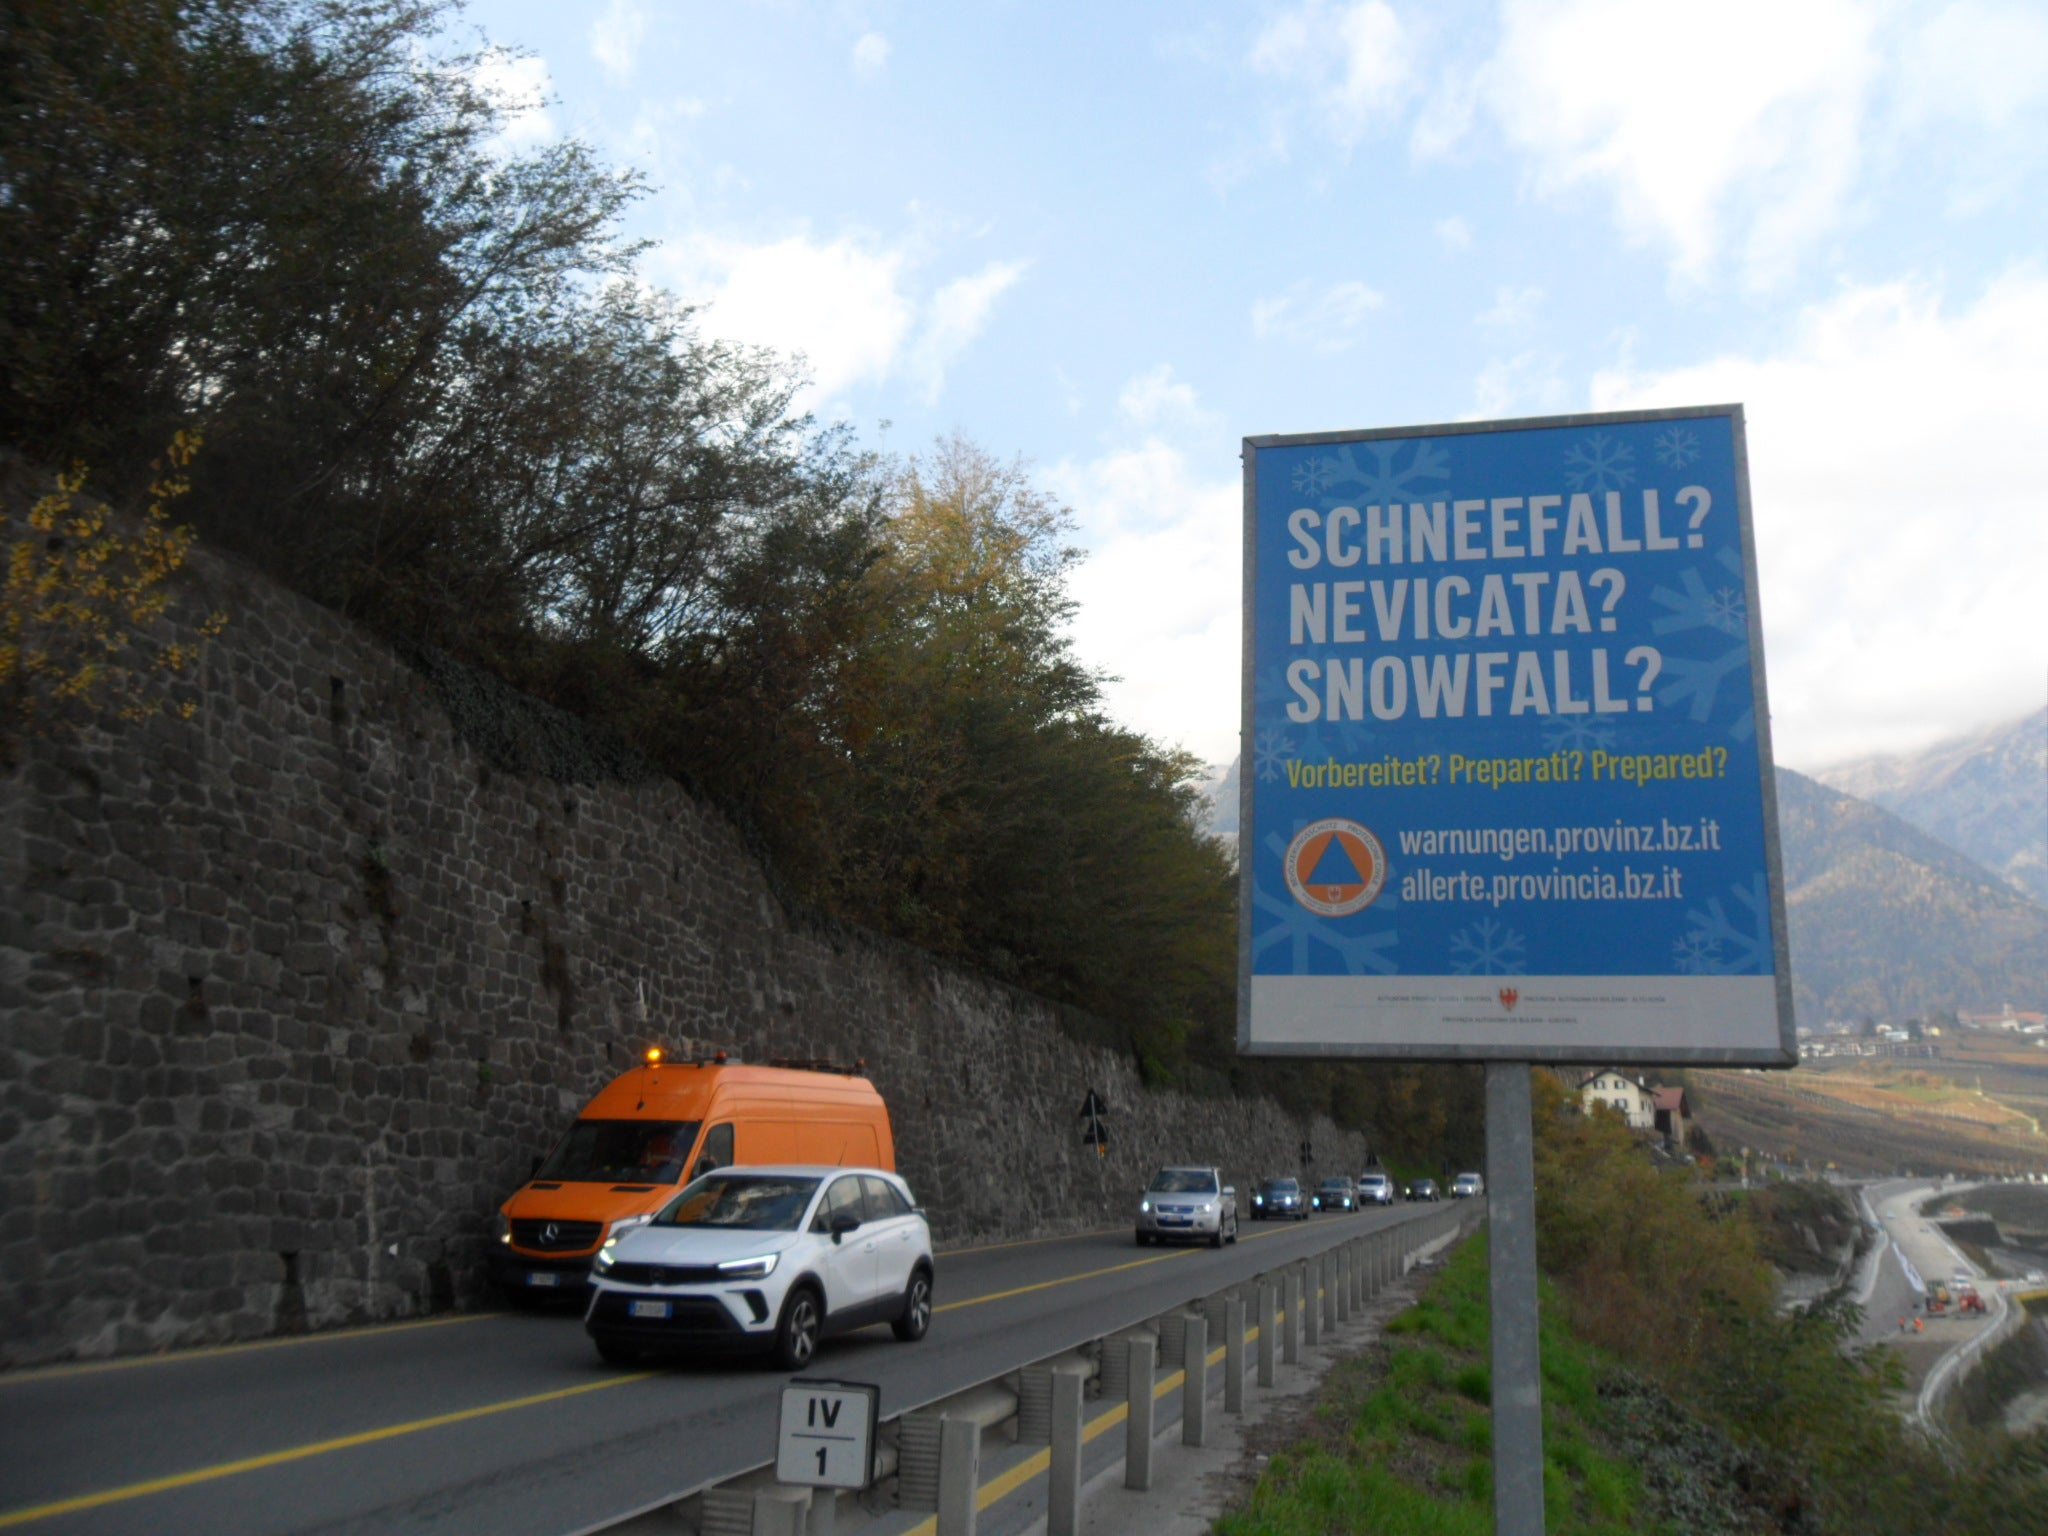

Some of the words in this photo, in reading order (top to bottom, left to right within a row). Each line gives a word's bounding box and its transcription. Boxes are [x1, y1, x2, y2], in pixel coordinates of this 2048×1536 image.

[1286, 485, 1712, 569] SCHNEEFALL?
[1290, 567, 1627, 645] NEVICATA?
[1286, 645, 1663, 723] SNOWFALL?
[1286, 754, 1442, 788] Vorbereitet?
[1449, 750, 1584, 789] Preparati?
[1592, 746, 1728, 787] Prepared?
[1399, 817, 1721, 860] warnungen.provinz.bz.it
[1401, 865, 1683, 908] allerte.provincia.bz.it
[808, 1398, 842, 1428] IV
[815, 1446, 827, 1476] 1
